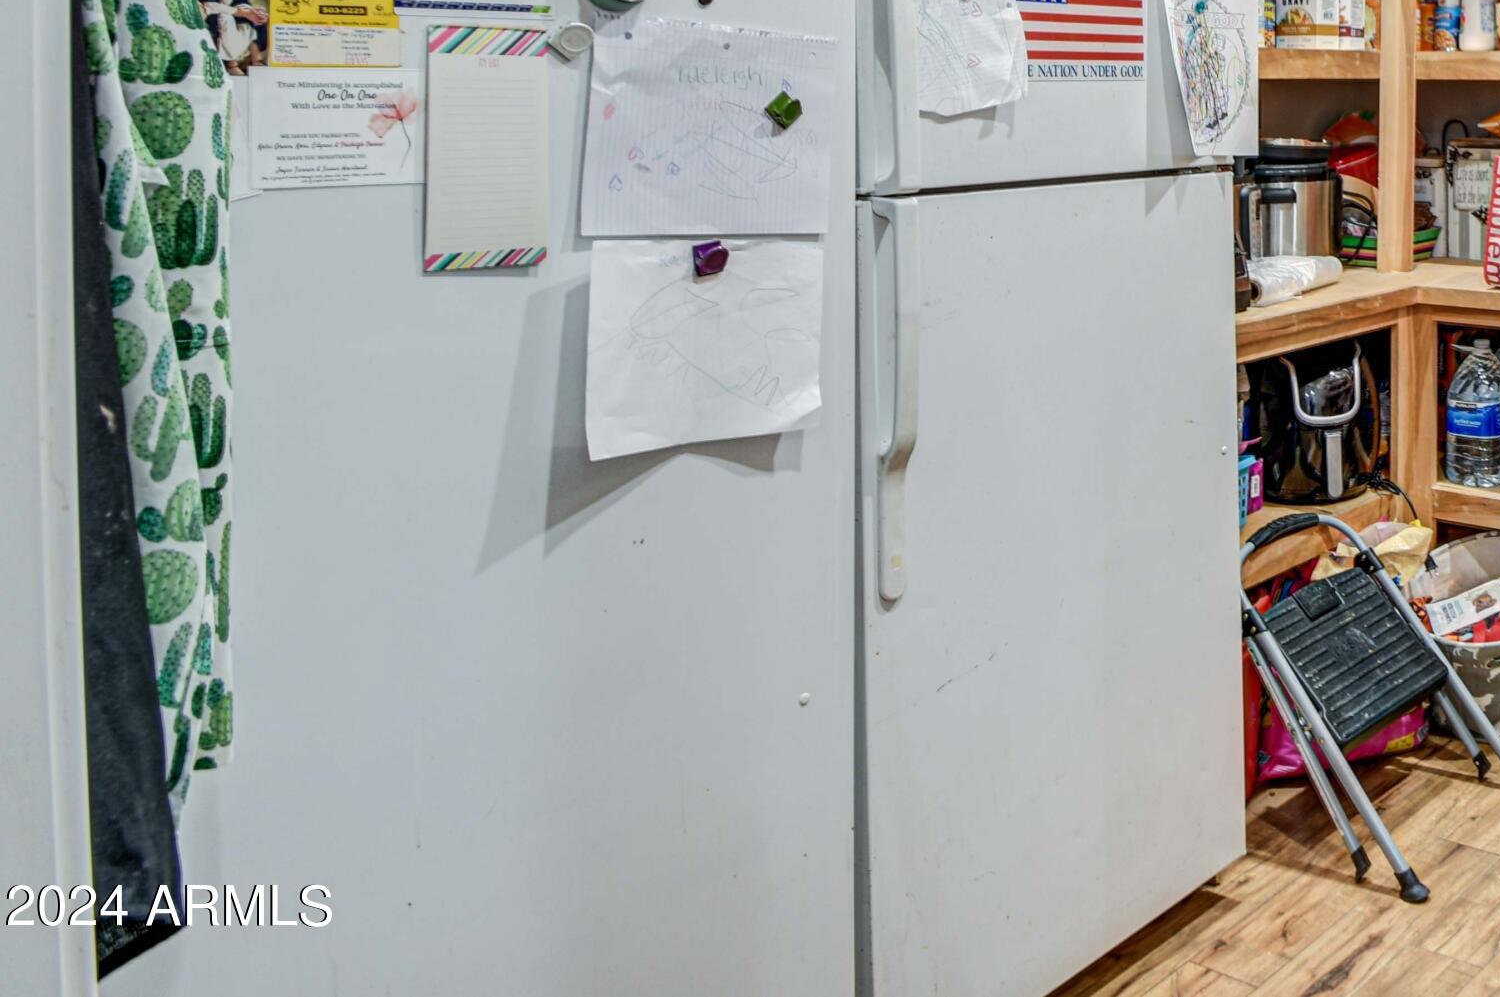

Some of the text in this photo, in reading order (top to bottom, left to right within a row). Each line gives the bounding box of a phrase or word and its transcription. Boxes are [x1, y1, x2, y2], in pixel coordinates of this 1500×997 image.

[1027, 64, 1143, 77] E NATION UNDER GOD!
[299, 81, 343, 90] Ministering
[353, 81, 403, 90] accomplished
[317, 89, 377, 101] One On One
